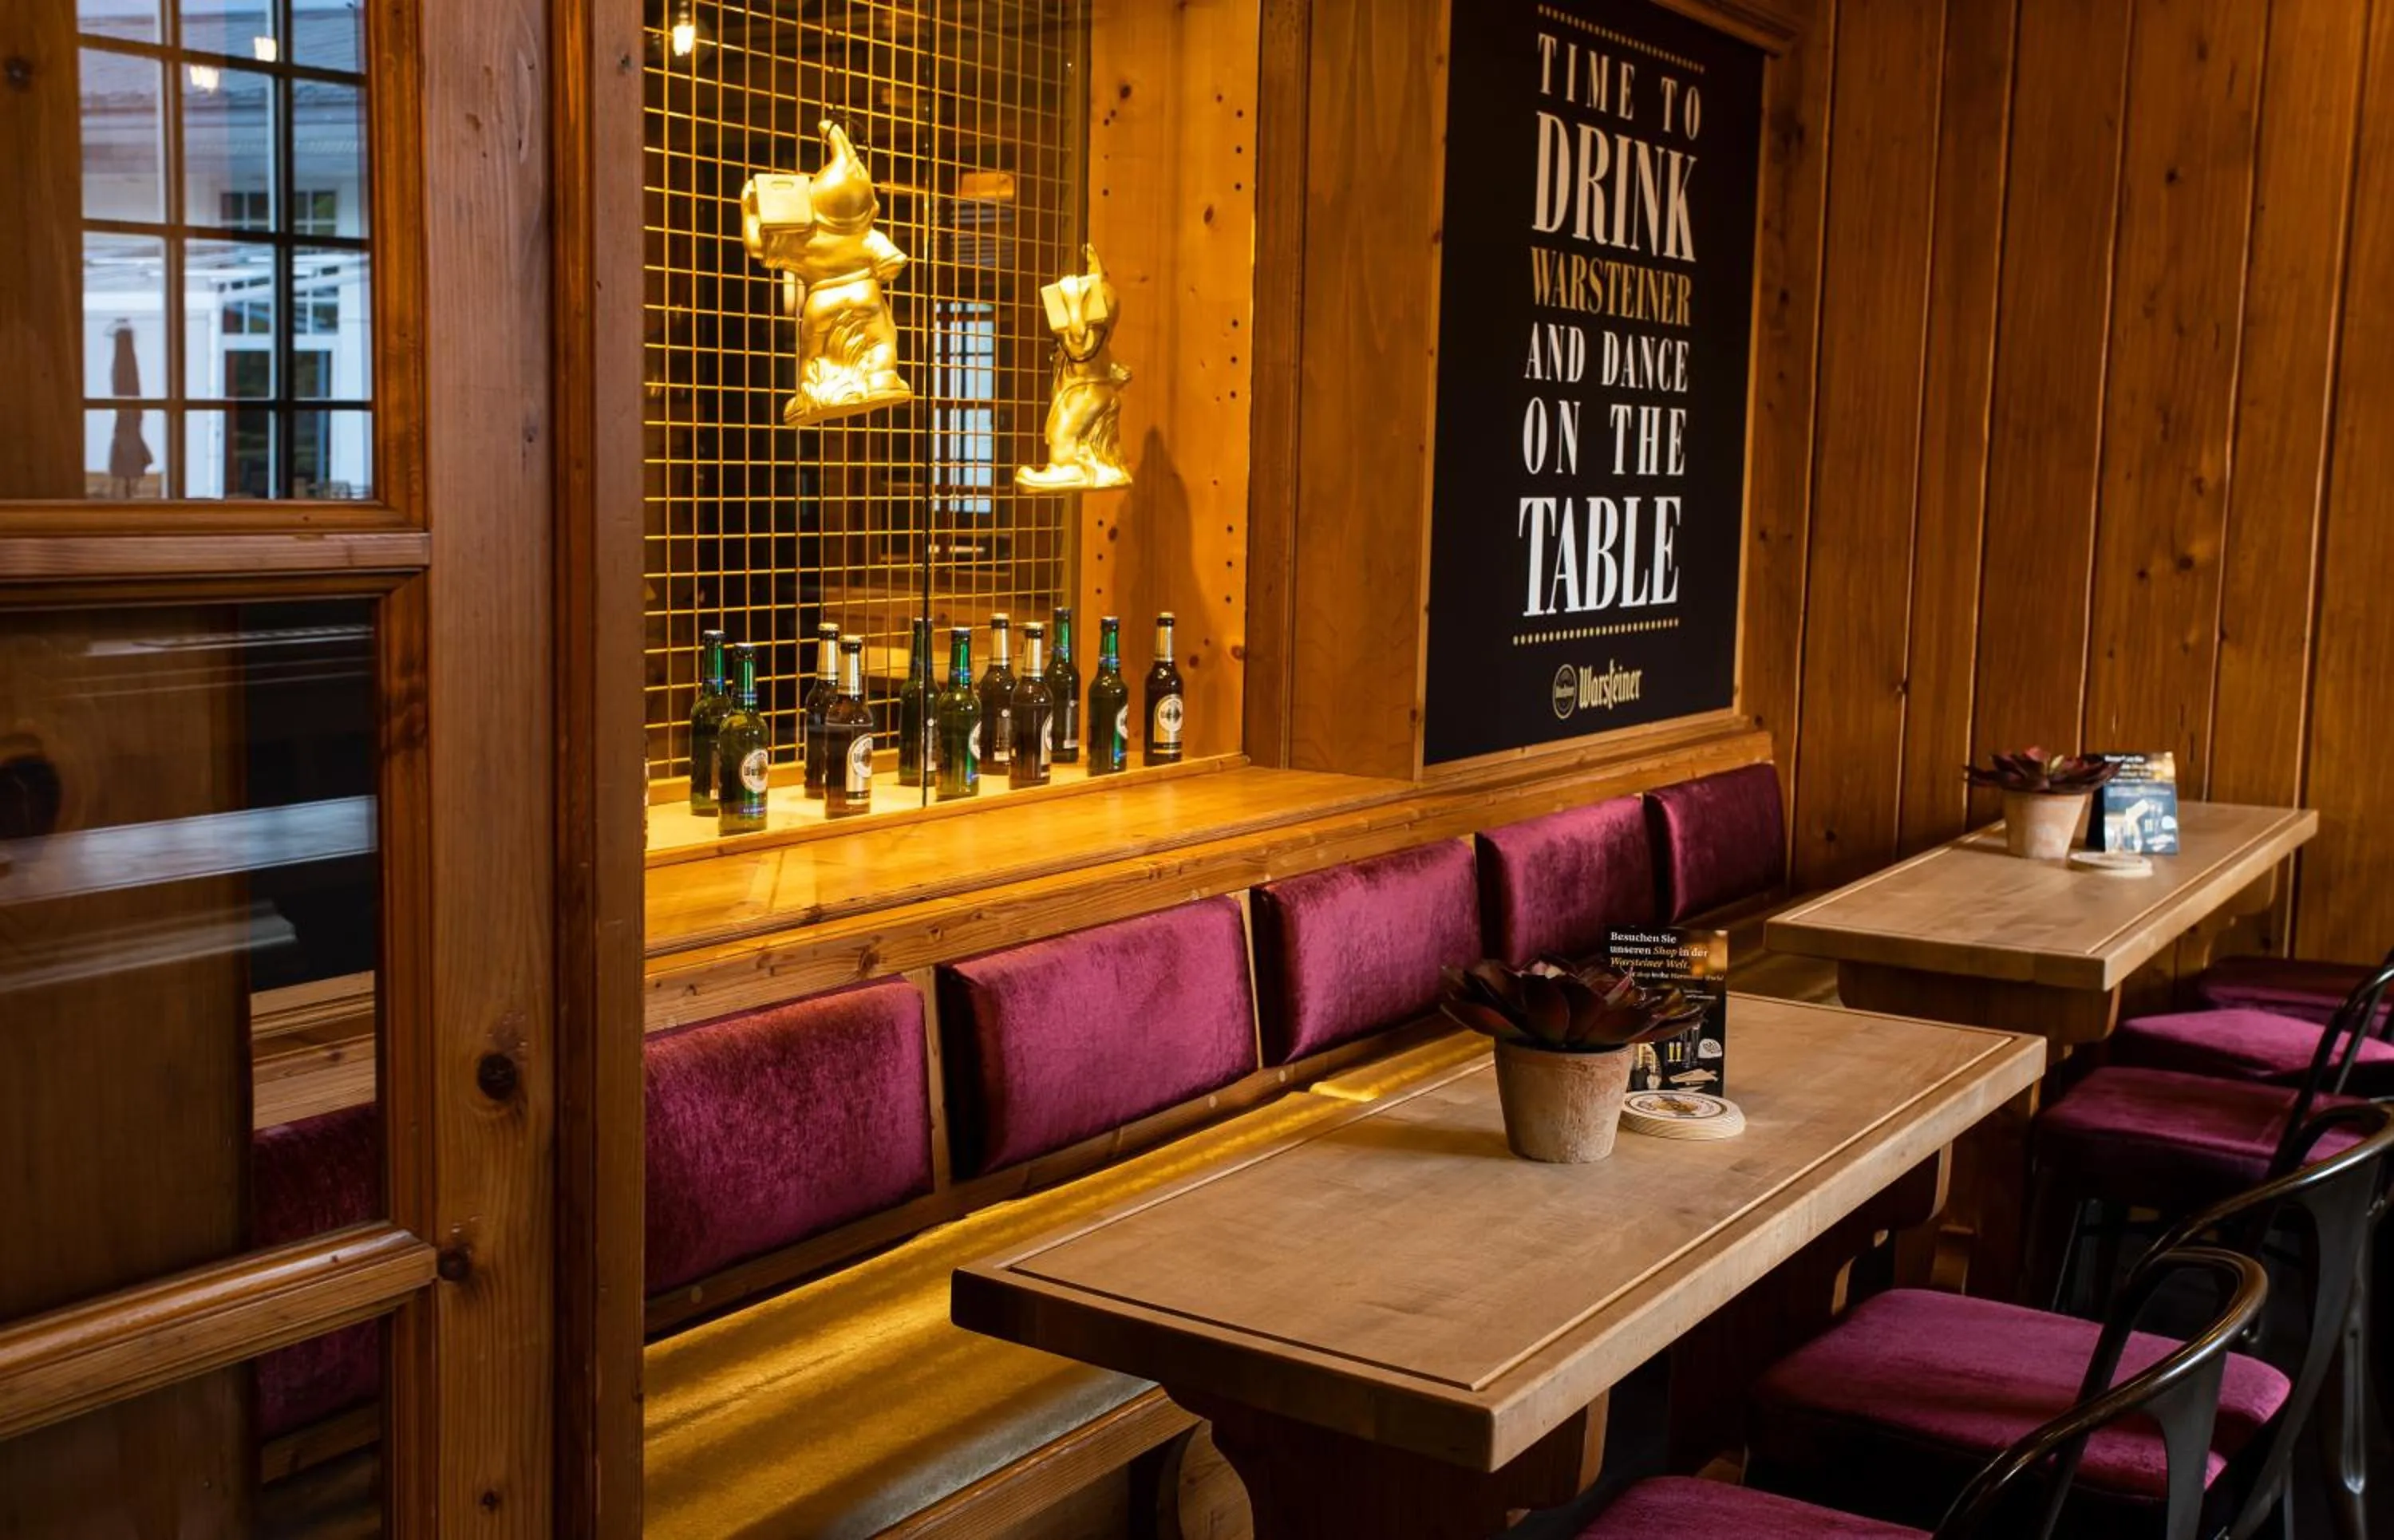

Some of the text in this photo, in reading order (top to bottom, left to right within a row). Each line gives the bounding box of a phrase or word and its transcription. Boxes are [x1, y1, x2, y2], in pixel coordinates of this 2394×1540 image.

[1538, 32, 1701, 140] TIME TO
[1531, 110, 1698, 263] DRINK
[1531, 246, 1692, 327] WARSTEINER
[1523, 322, 1690, 393] AND DANCE
[1523, 397, 1687, 476] ON THE
[1518, 496, 1681, 617] TABLE
[1579, 657, 1642, 710] Warsteiner
[1610, 931, 1677, 944] Besuchen Sie
[1610, 945, 1709, 958] unseren Shop in der
[1610, 957, 1665, 968] Warsteiner
